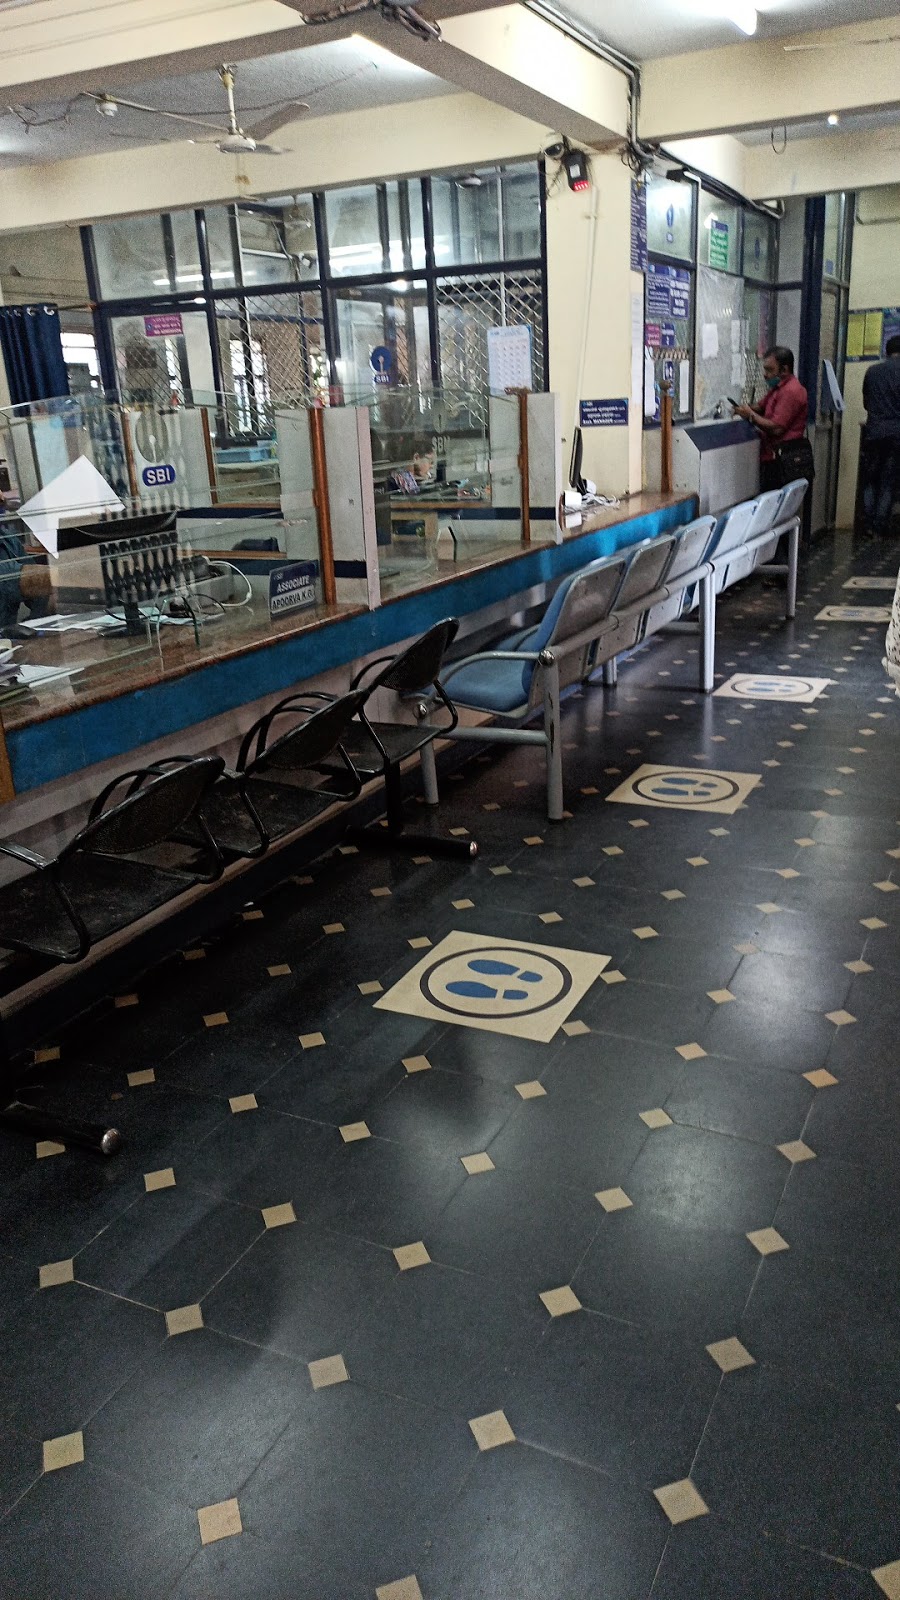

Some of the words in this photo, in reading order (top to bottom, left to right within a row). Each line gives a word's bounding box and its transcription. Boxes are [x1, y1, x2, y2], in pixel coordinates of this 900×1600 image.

[376, 375, 389, 383] SBI
[146, 467, 171, 485] SBI
[276, 575, 310, 594] ASSOCIATE
[272, 592, 301, 610] APOORVA
